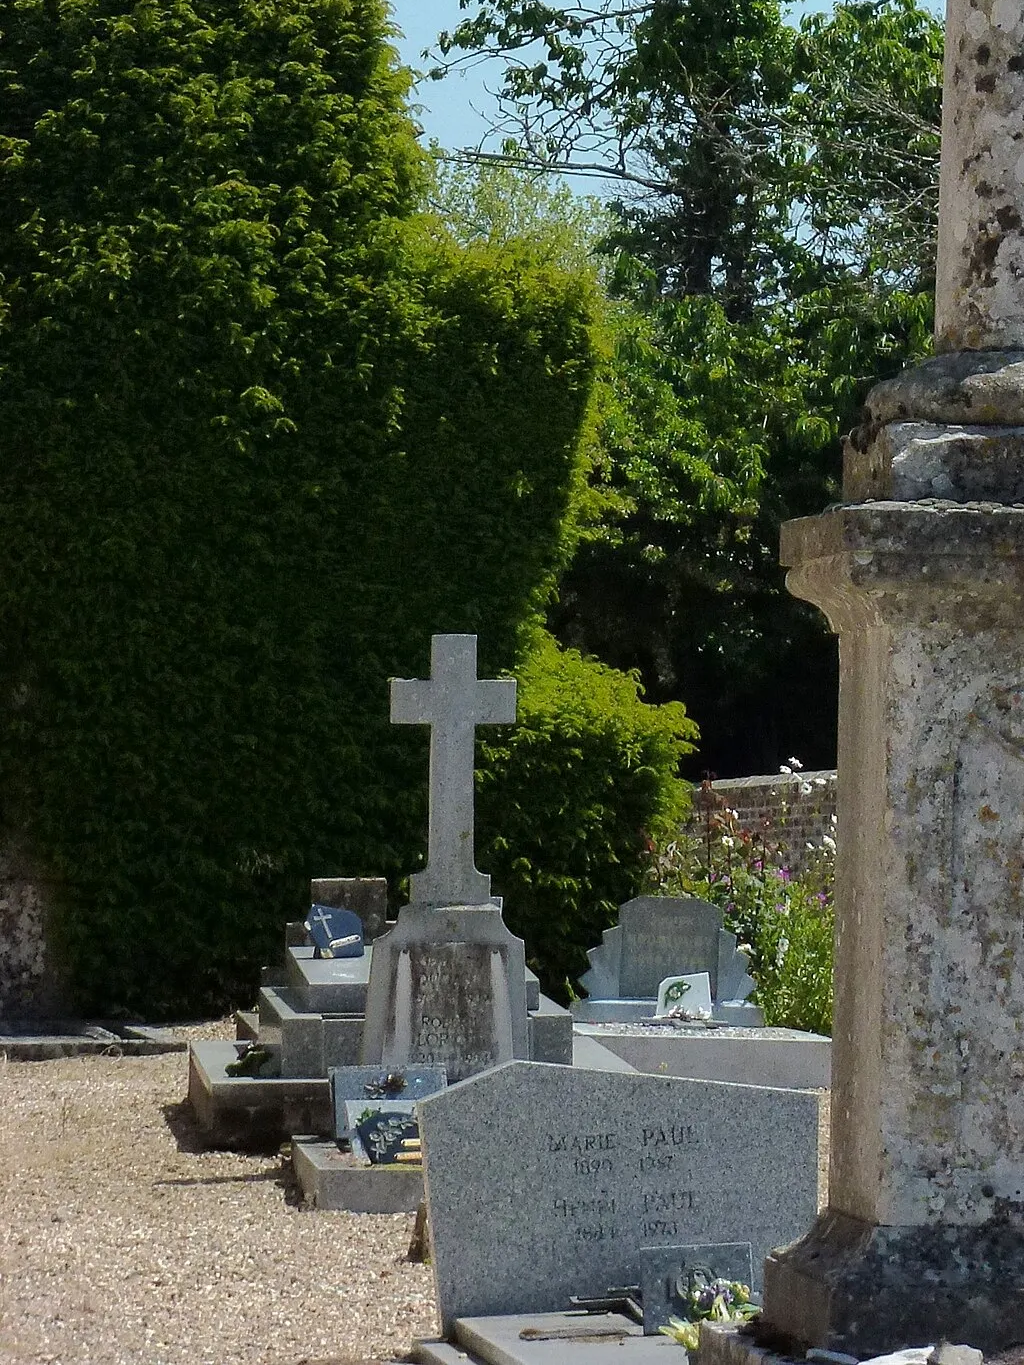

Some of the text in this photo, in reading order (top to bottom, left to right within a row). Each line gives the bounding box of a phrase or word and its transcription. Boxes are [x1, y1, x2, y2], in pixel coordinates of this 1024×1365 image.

[549, 1125, 699, 1152] MARIE PAUL
[643, 1190, 695, 1214] PAUL
